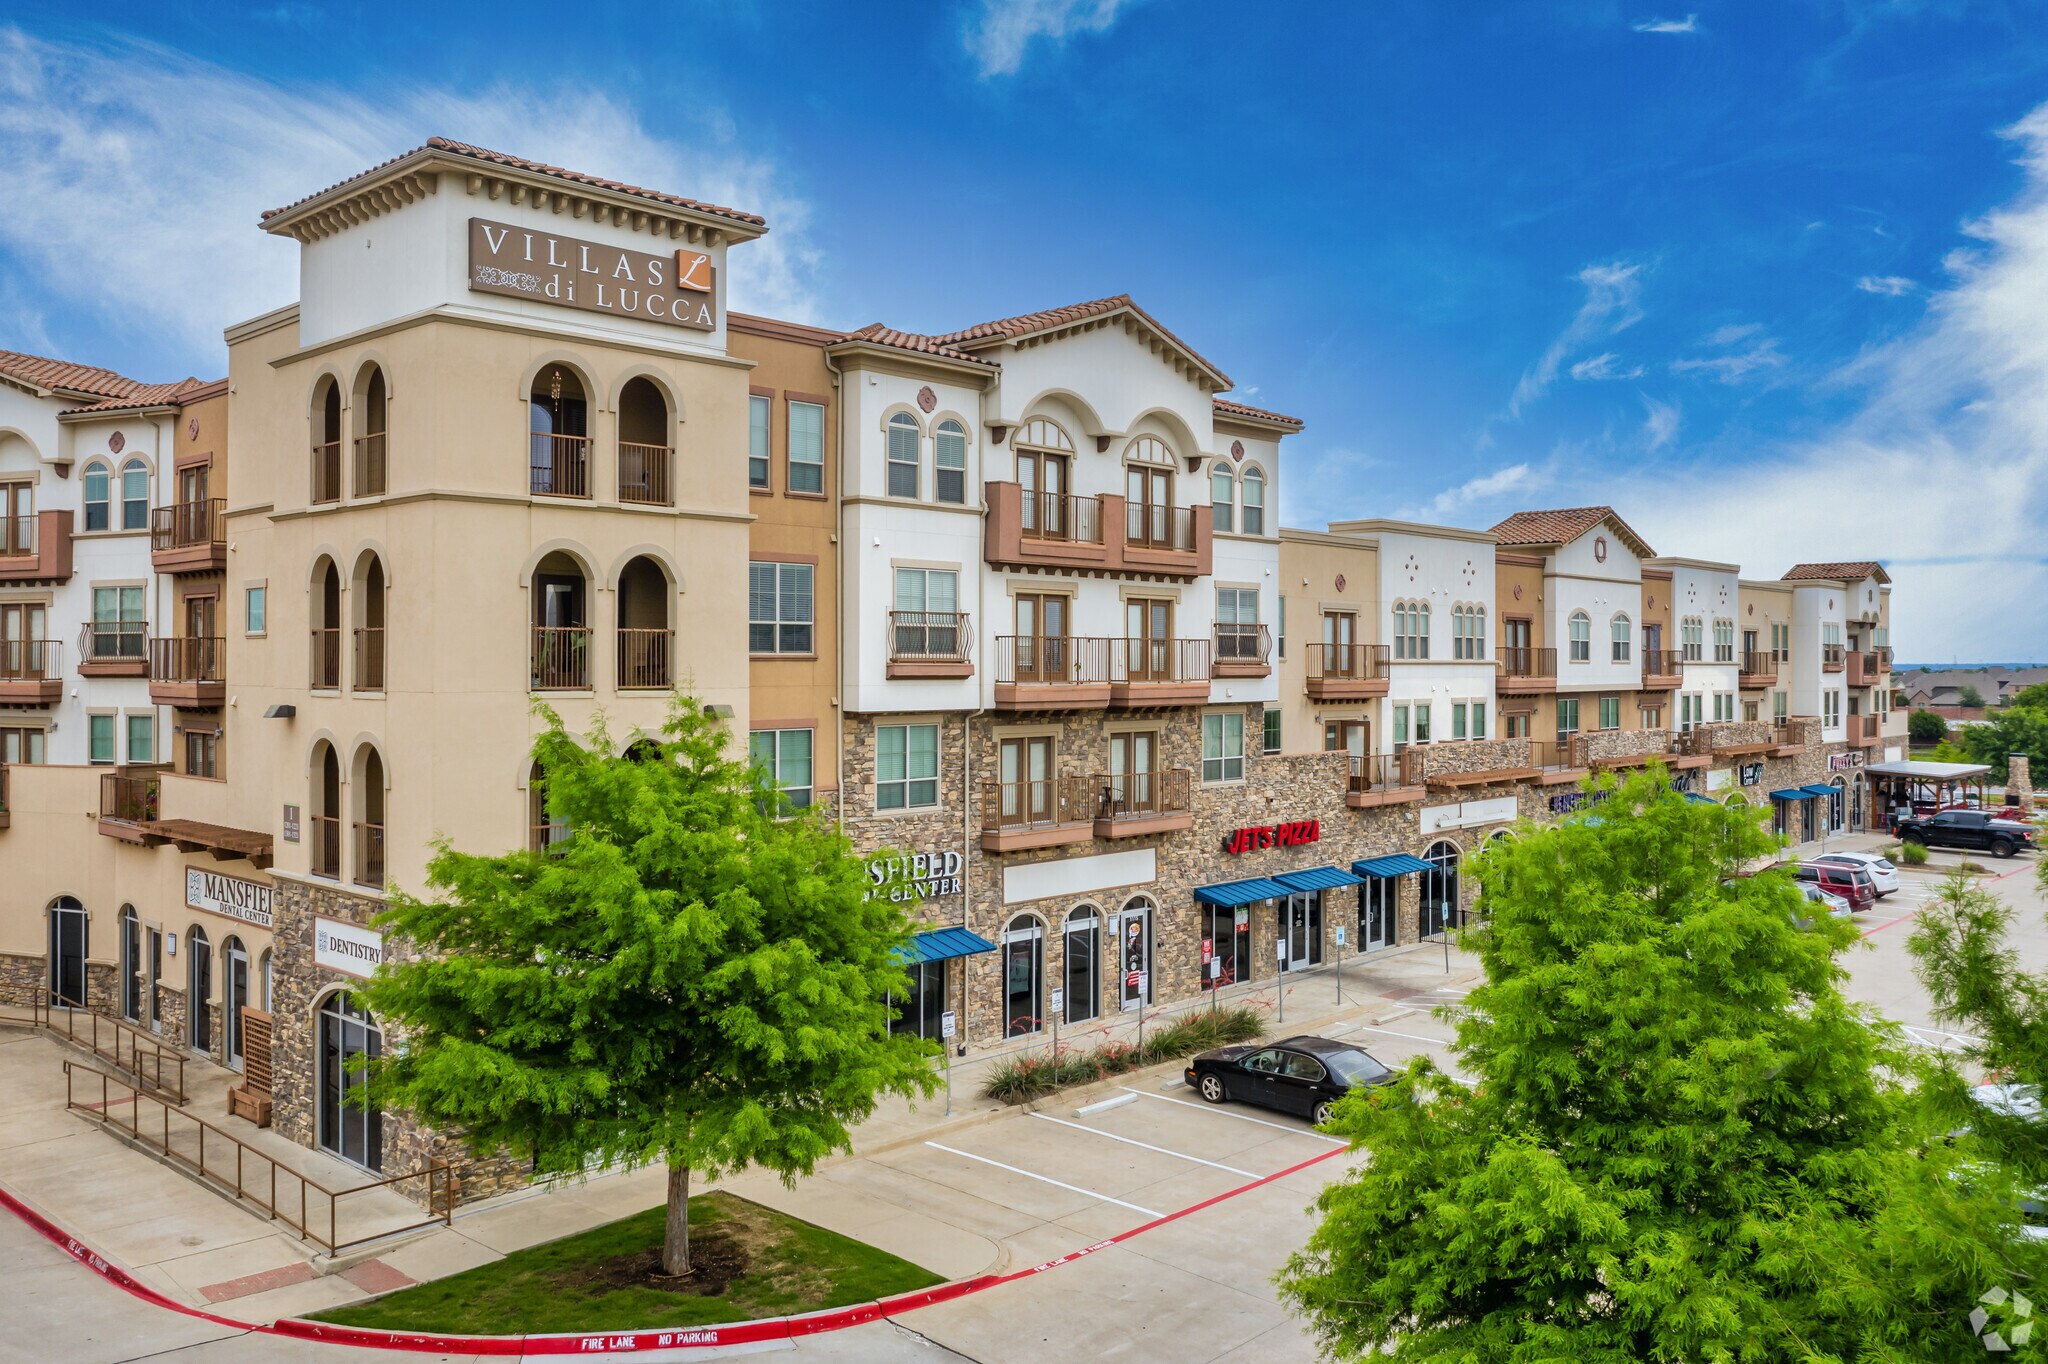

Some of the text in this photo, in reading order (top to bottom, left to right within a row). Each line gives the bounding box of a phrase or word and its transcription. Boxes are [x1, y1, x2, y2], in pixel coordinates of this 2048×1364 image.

[481, 225, 663, 286] VILLAS
[545, 274, 714, 326] di LUCCA
[1229, 820, 1319, 854] JET'S PIZZA
[863, 851, 962, 886] SFIELD
[220, 902, 270, 925] DENTAL CENTER
[330, 936, 381, 963] DENTISTRY
[582, 1331, 718, 1350] FIRE LANE NO PARKING
